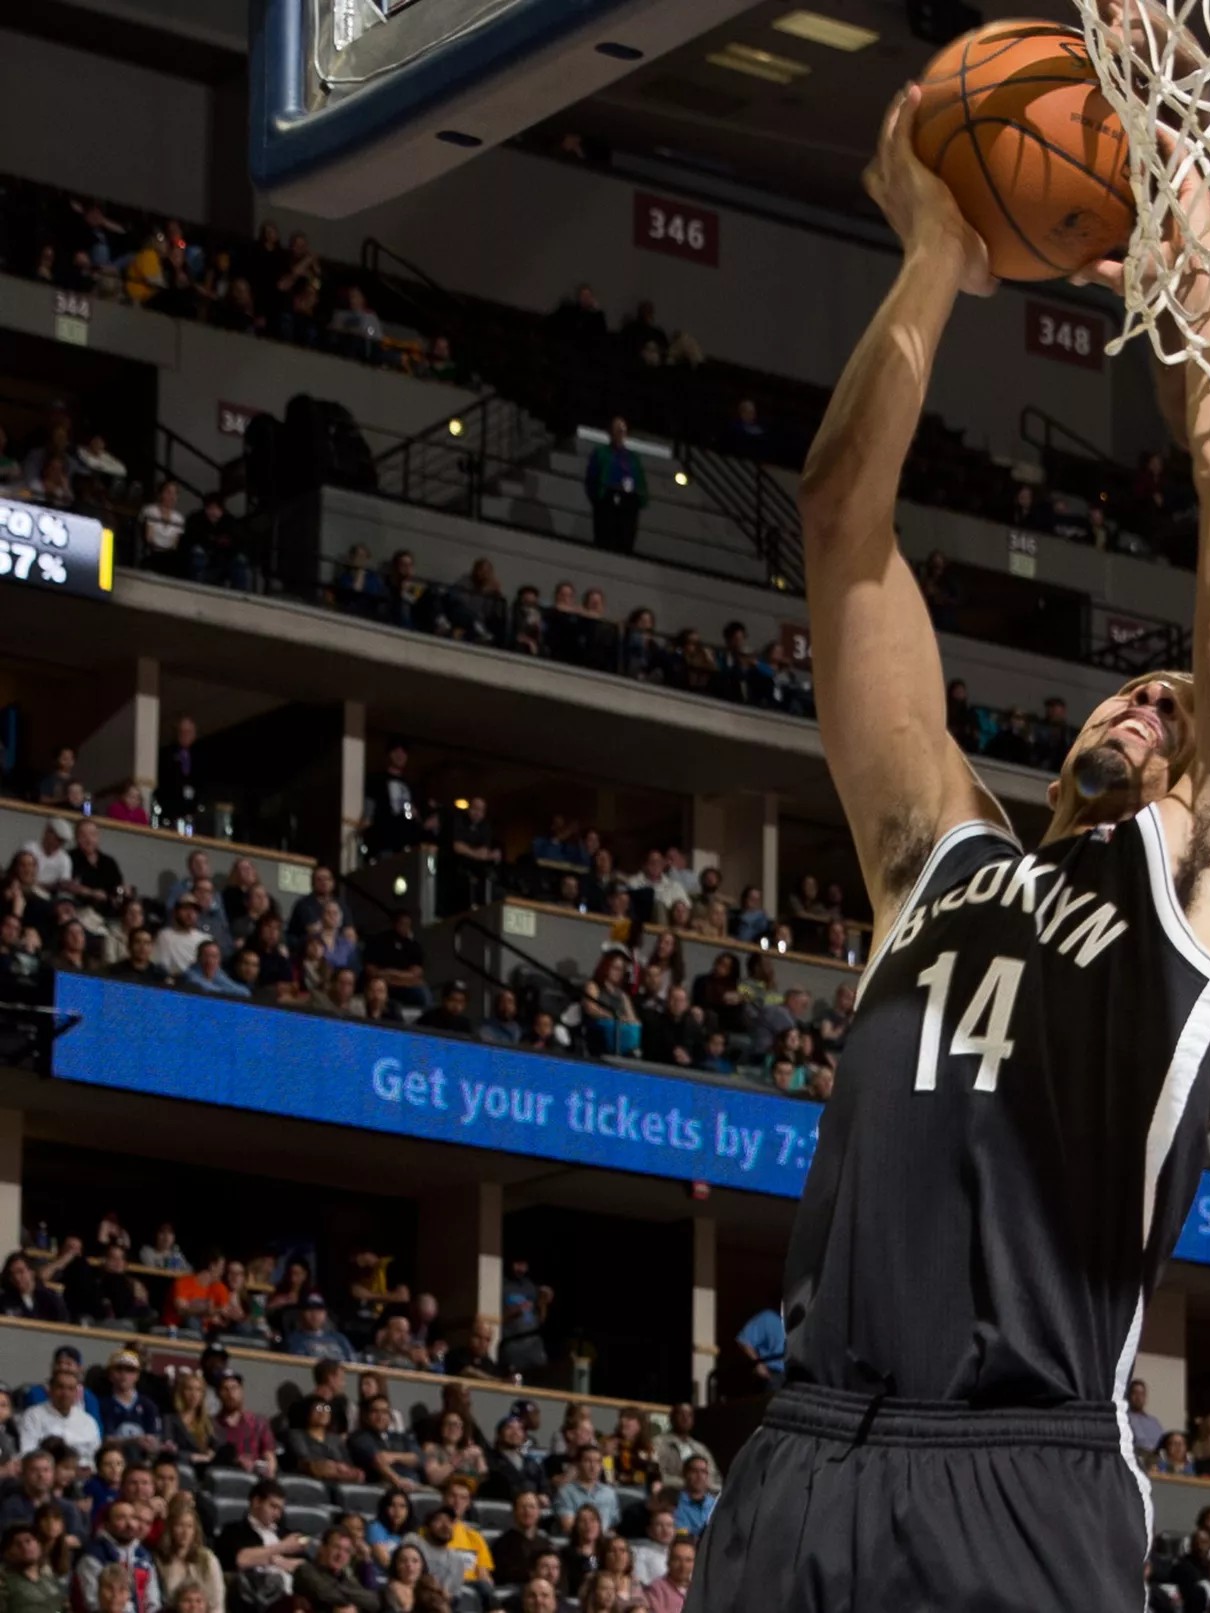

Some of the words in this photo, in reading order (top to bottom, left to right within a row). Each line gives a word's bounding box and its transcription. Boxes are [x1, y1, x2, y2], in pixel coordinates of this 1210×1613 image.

[647, 205, 706, 251] 346
[1038, 314, 1091, 356] 348
[914, 951, 1026, 1092] 14
[372, 1057, 448, 1111] Get
[460, 1078, 554, 1127] your
[565, 1087, 702, 1151] tickets
[714, 1111, 761, 1172] by
[774, 1124, 819, 1169] 7:
